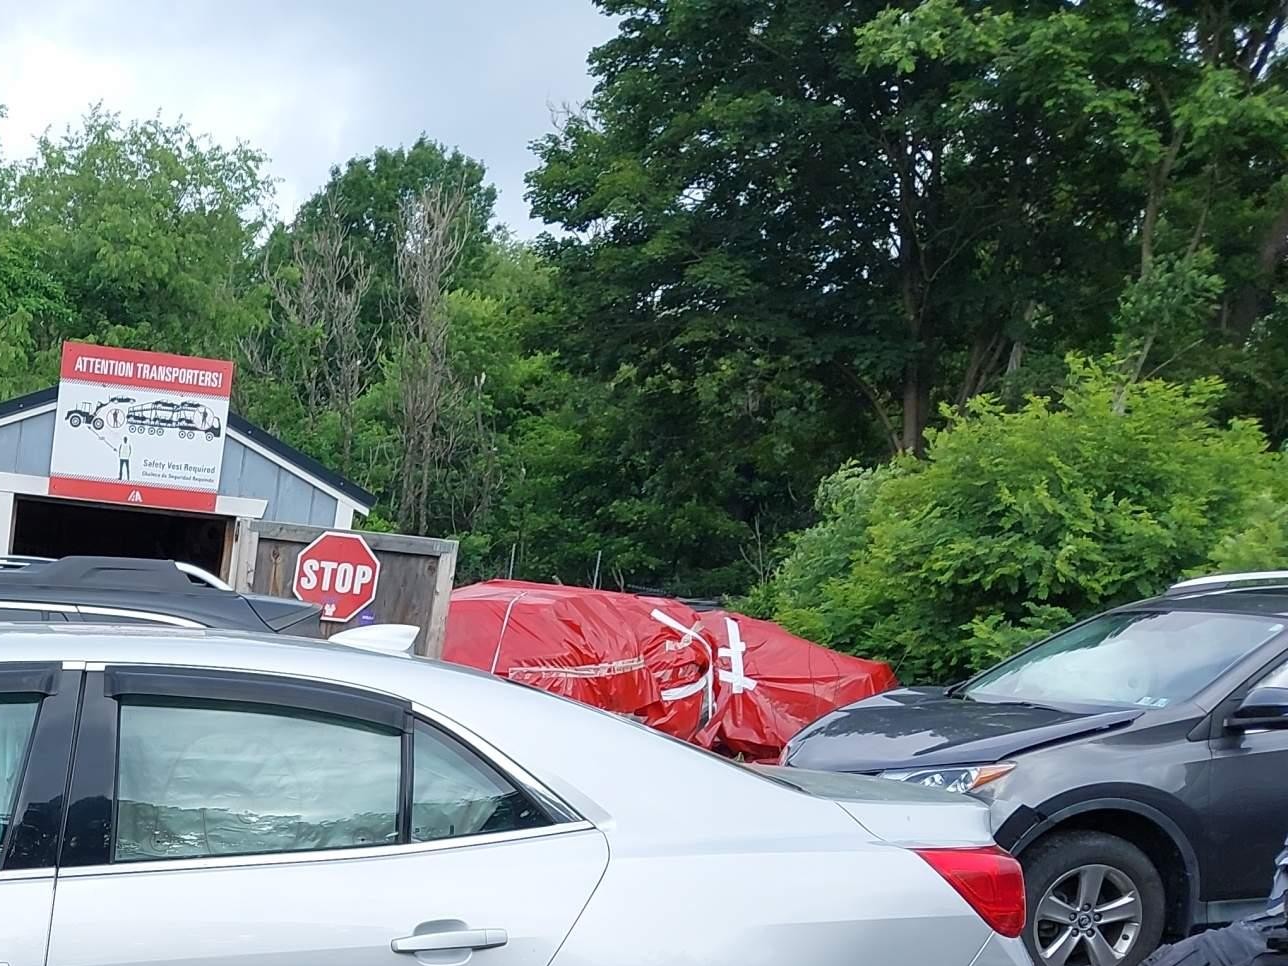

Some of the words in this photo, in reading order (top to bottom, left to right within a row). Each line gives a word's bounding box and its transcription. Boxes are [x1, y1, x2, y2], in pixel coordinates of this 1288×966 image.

[74, 356, 133, 378] ATTENTION
[137, 363, 223, 388] TRANSPORTERS!
[143, 459, 166, 471] Safety
[167, 461, 182, 471] Vest
[183, 463, 216, 474] Required
[300, 559, 373, 595] STOP
